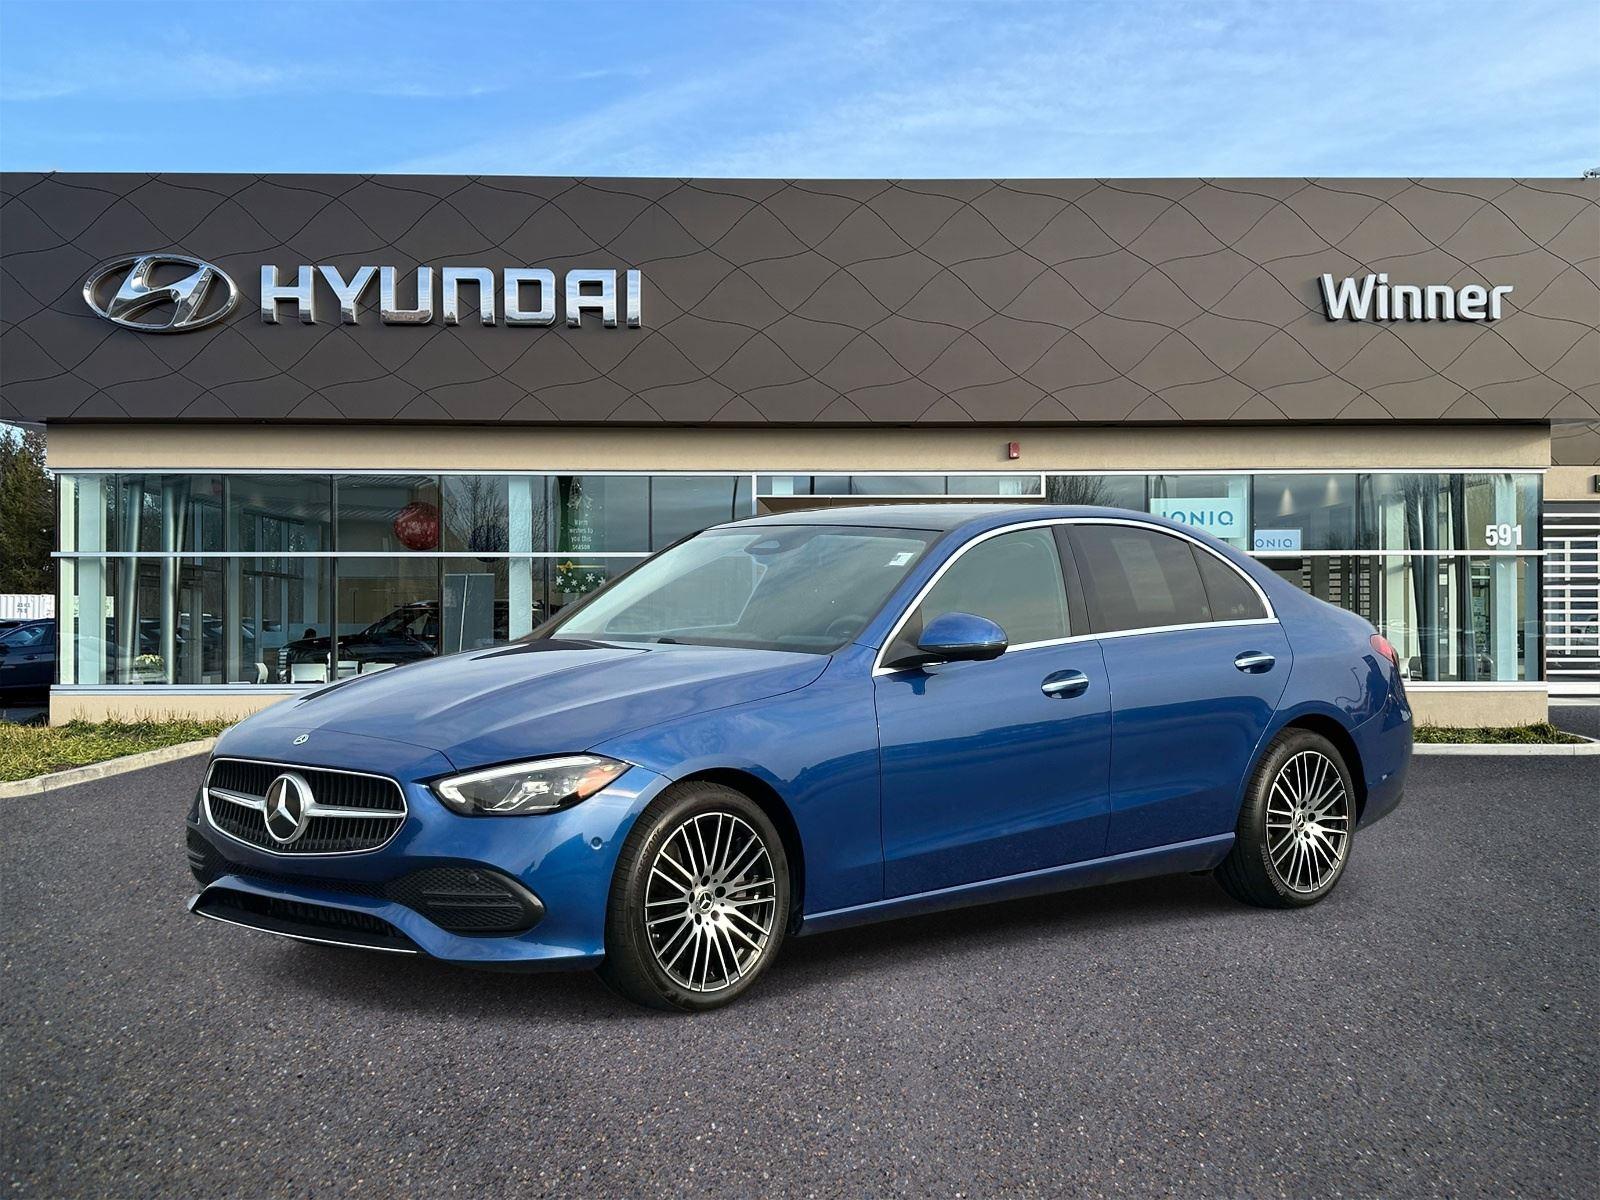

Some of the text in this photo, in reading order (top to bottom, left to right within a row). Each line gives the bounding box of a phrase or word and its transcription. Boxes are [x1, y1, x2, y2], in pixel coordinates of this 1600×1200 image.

[260, 265, 642, 327] HYUNDAI
[1320, 273, 1514, 320] Winner
[1255, 538, 1293, 548] ONIQ
[1485, 523, 1523, 546] 591
